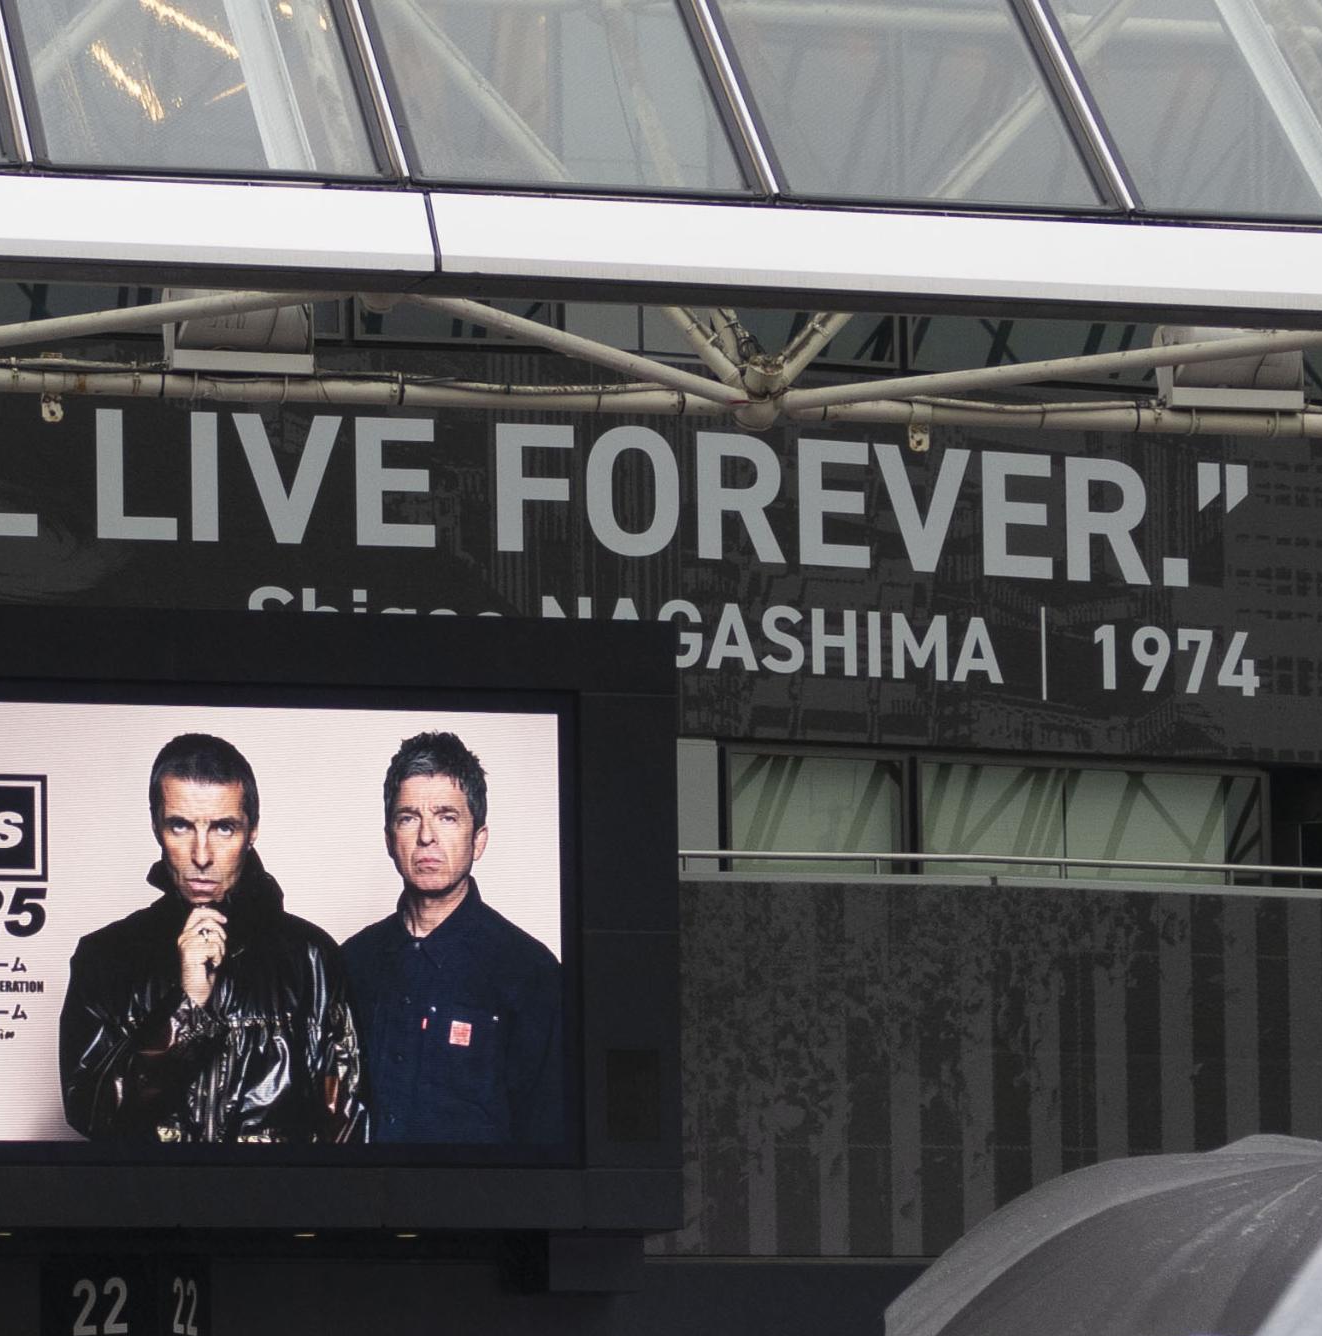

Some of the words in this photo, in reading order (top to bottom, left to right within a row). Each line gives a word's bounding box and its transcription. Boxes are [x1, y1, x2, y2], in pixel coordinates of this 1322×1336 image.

[96, 408, 436, 548] LIVE
[1093, 624, 1260, 696] 1974
[73, 1277, 128, 1336] 22
[173, 1277, 198, 1336] 22
